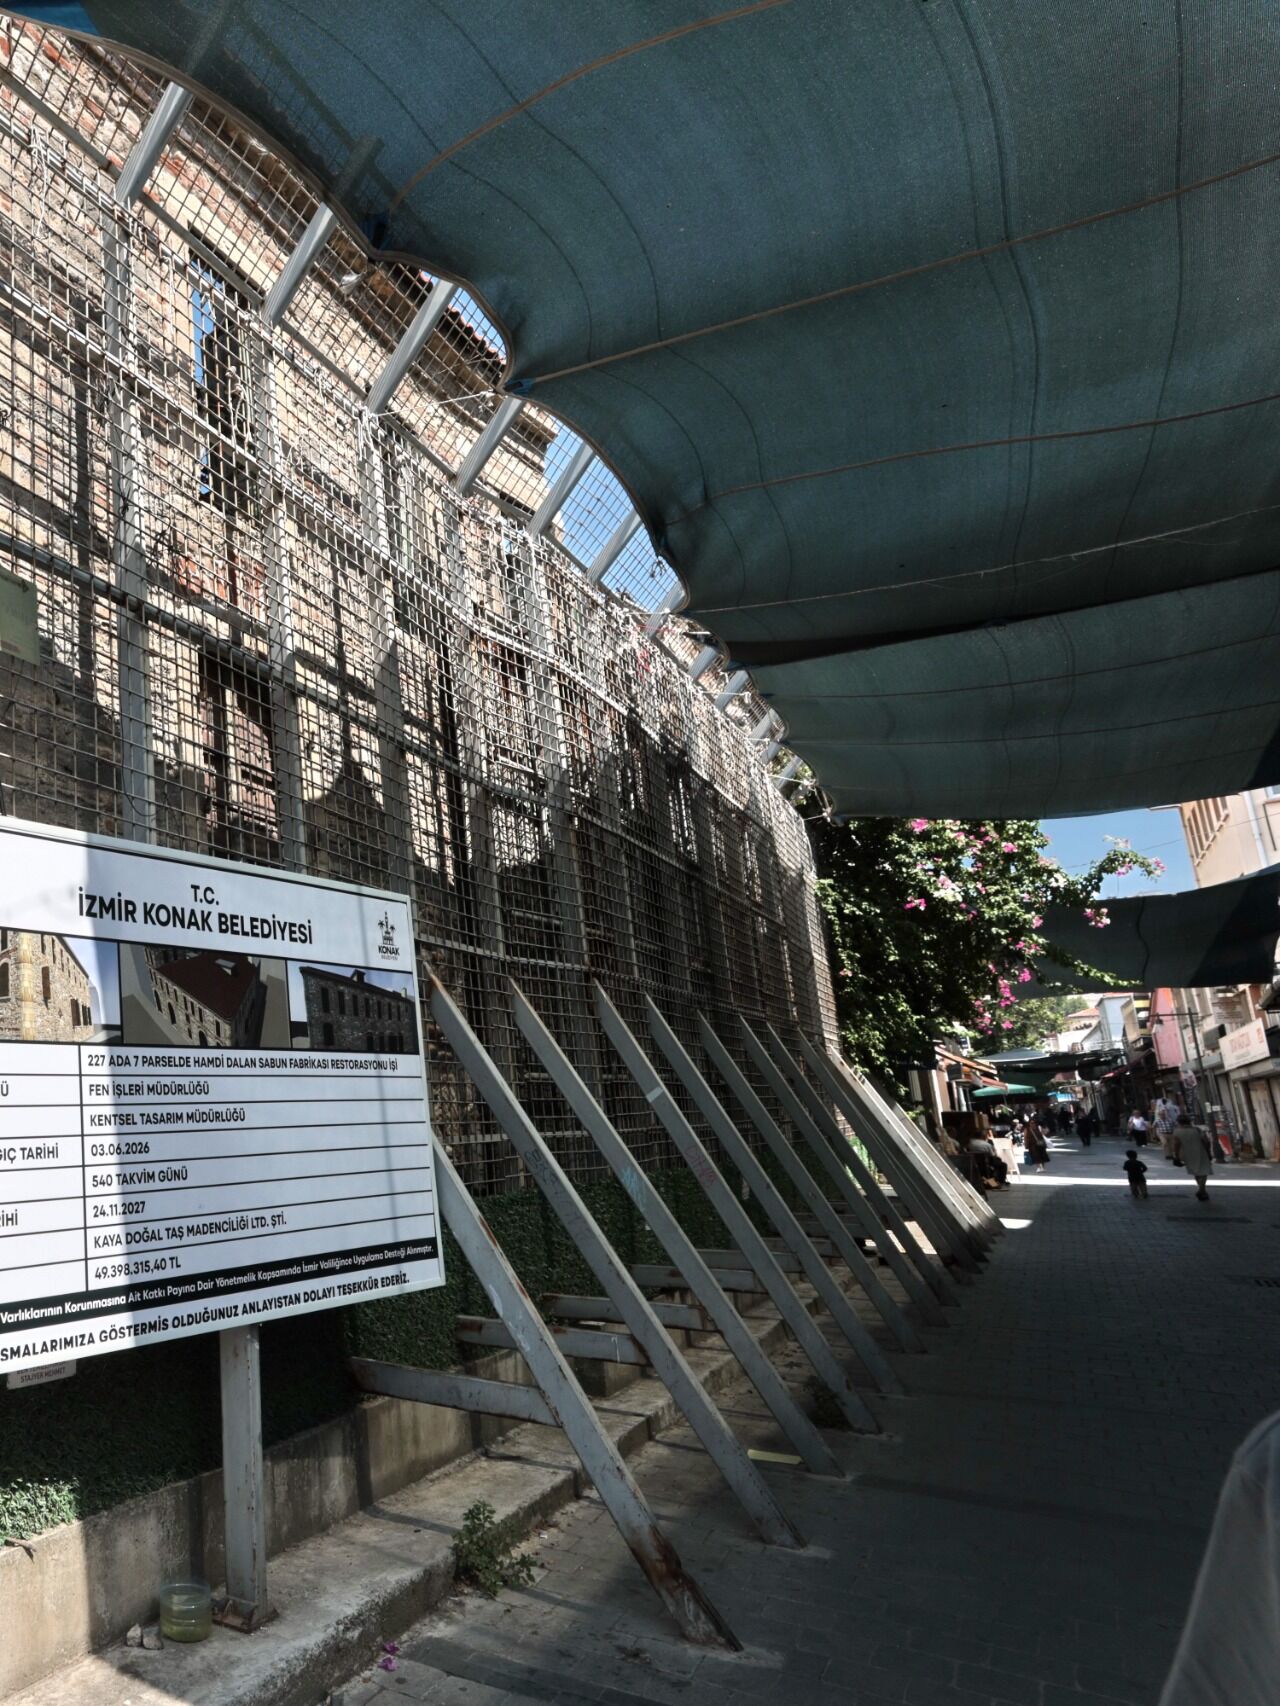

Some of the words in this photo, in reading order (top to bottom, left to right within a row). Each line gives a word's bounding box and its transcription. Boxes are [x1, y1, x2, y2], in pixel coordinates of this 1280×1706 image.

[191, 884, 220, 905] T.C.
[78, 887, 137, 923] İZMİR
[143, 903, 213, 932] KONAK
[219, 912, 313, 944] BELEDİYESİ
[378, 945, 400, 956] KONAK
[87, 1055, 106, 1067] 227
[108, 1055, 131, 1067] ADA
[133, 1056, 139, 1067] 7
[141, 1055, 191, 1068] PARSELDE
[193, 1054, 224, 1068] HAMDİ
[226, 1057, 256, 1068] DALAN
[258, 1057, 287, 1069] SABUN
[289, 1056, 329, 1070] FABRİKASI
[330, 1059, 388, 1071] RESTORASYONU
[389, 1057, 398, 1072] İŞİ
[89, 1084, 109, 1096] FEN
[112, 1081, 144, 1099] İŞLERİ
[147, 1081, 209, 1096] MÜDÜRLÜĞÜ
[90, 1113, 137, 1127] KENTSEL
[139, 1111, 184, 1125] TASARIM
[186, 1108, 246, 1124] MÜDÜRLÜĞÜ
[20, 1142, 59, 1160] TARİHİ
[90, 1141, 150, 1157] 03.06.2026
[92, 1174, 113, 1188] 540
[116, 1168, 156, 1186] TAKVİM
[158, 1166, 188, 1182] GÜNÜ
[93, 1201, 146, 1218] 24.11.2027
[94, 1234, 123, 1249] KAYA
[125, 1227, 163, 1245] DOĞAL
[165, 1226, 184, 1241] TAŞ
[186, 1215, 249, 1237] MADENCİLİĞİ
[251, 1215, 270, 1229] LTD.
[271, 1211, 287, 1229] ŞTİ.
[94, 1258, 167, 1280] 49.398.315,40
[168, 1256, 182, 1269] TL
[0, 1304, 63, 1324] Varlıklarının
[64, 1294, 126, 1314] Korunmasına
[128, 1290, 141, 1303] Ait
[143, 1286, 166, 1301] Katkı
[167, 1282, 196, 1298] Payına
[197, 1277, 214, 1291] Dair
[215, 1271, 256, 1288] Yönetmelik
[257, 1264, 302, 1282] Kapsamında
[302, 1260, 319, 1273] İzmir
[353, 1251, 384, 1267] Uygulama
[171, 1305, 239, 1329] OLDUĞUNUZ
[303, 1287, 336, 1303] DOLAYI
[380, 1270, 410, 1289] EDERİZ.
